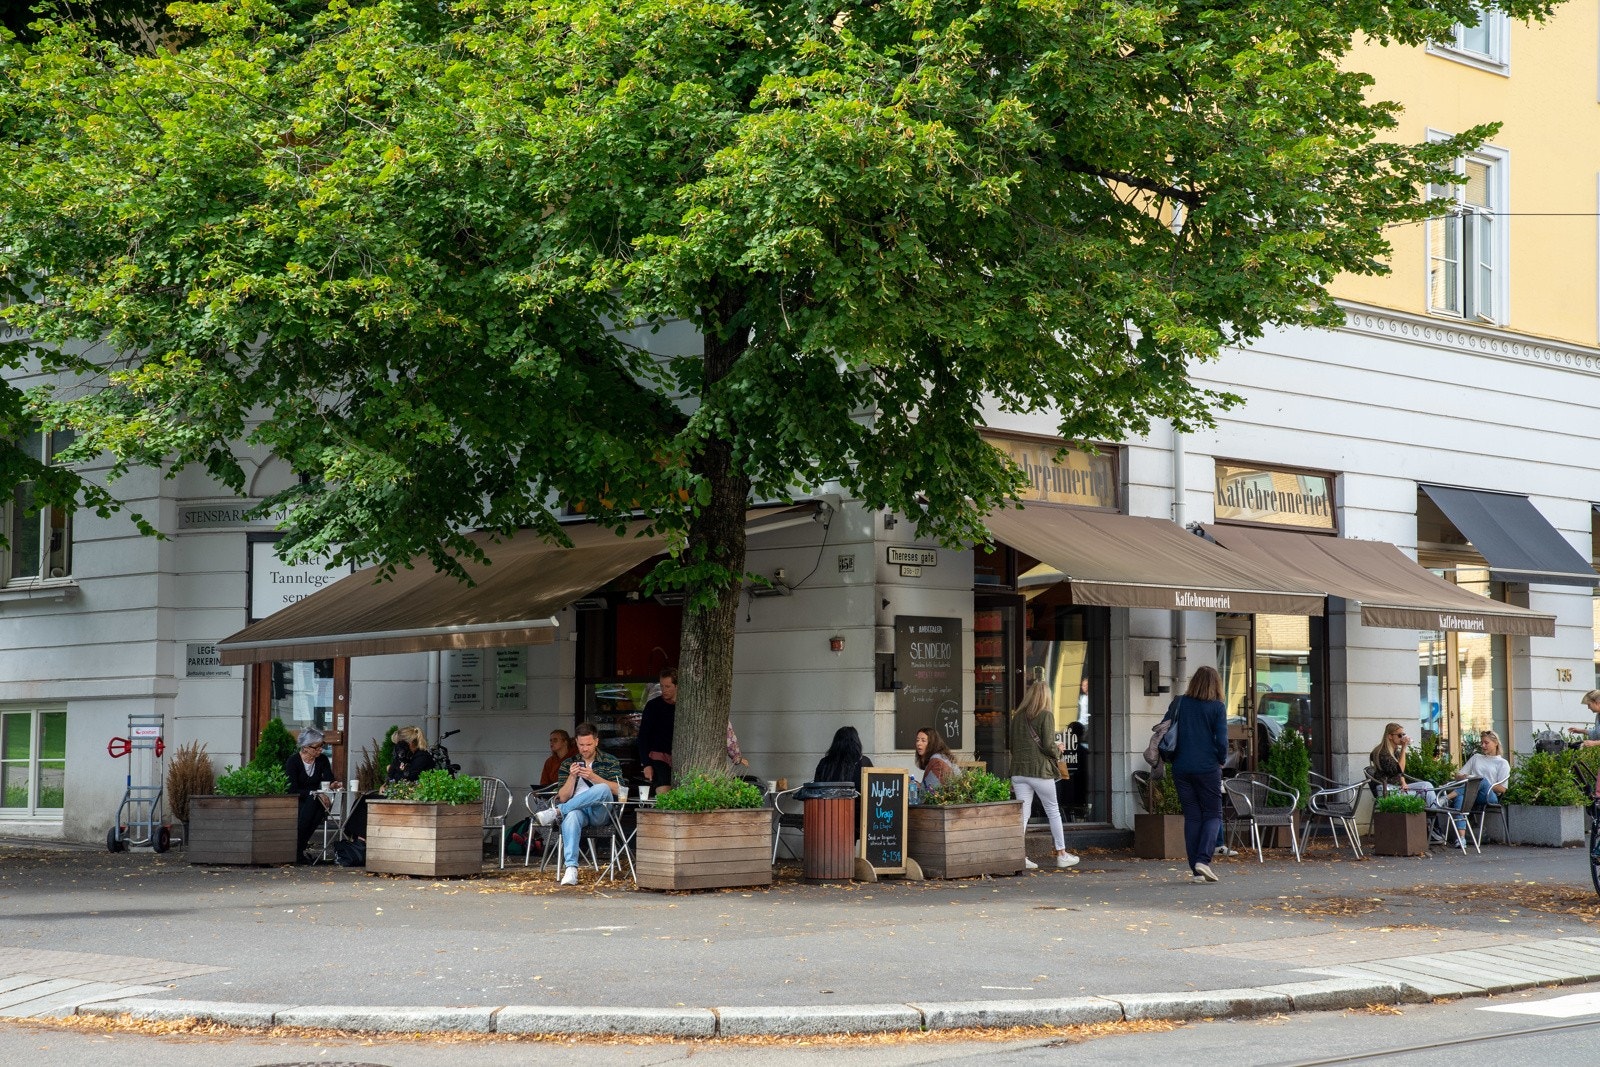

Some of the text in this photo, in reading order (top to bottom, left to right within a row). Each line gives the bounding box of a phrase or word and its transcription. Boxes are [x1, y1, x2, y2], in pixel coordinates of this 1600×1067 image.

[1215, 477, 1329, 517] Kaffebrenneriet
[892, 549, 934, 564] Thereses gate
[269, 571, 336, 588] Tannlege-
[1175, 591, 1231, 609] Kaffebrenneriet
[1438, 614, 1485, 631] Kaffebrenneriet
[909, 641, 952, 660] SENDERO
[187, 657, 222, 666] PARKERIN
[1056, 727, 1078, 751] affe
[871, 779, 900, 807] Nyhet!
